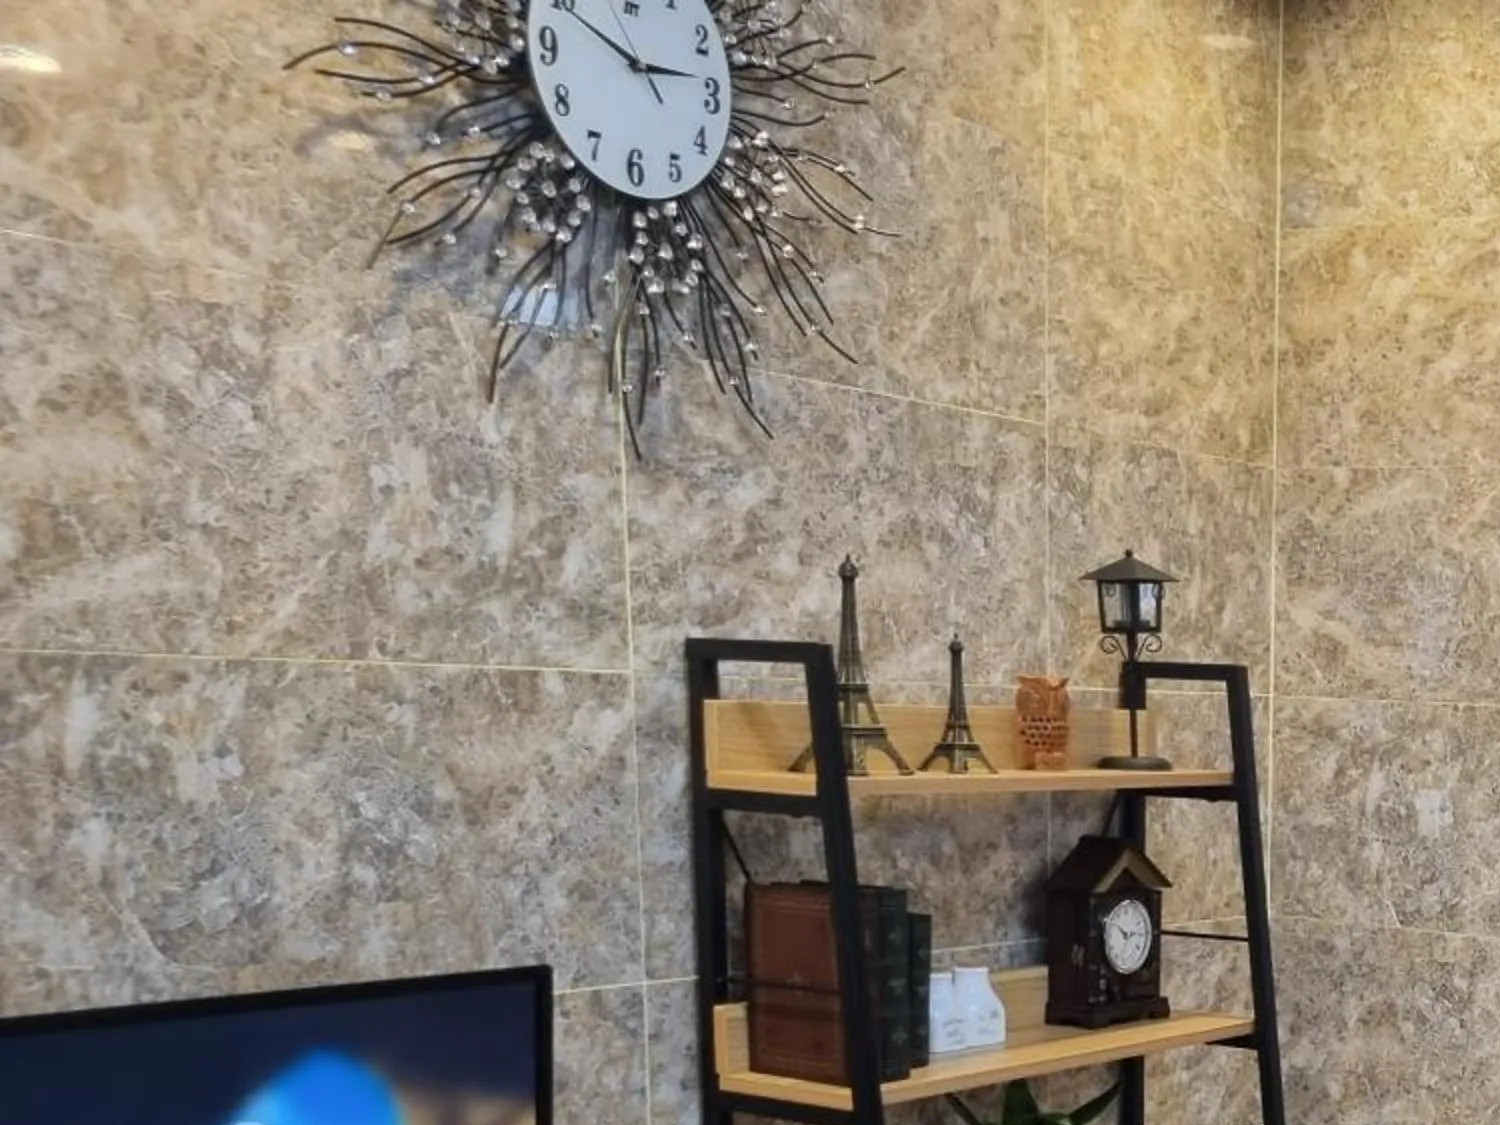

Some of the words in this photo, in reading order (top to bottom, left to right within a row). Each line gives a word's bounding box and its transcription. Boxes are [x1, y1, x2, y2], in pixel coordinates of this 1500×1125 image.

[539, 26, 558, 66] 9
[695, 24, 709, 57] 2
[554, 84, 570, 117] 8
[703, 77, 721, 115] 3
[587, 129, 602, 162] 7
[693, 125, 708, 157] 4
[627, 149, 645, 187] 6
[669, 153, 682, 183] 5
